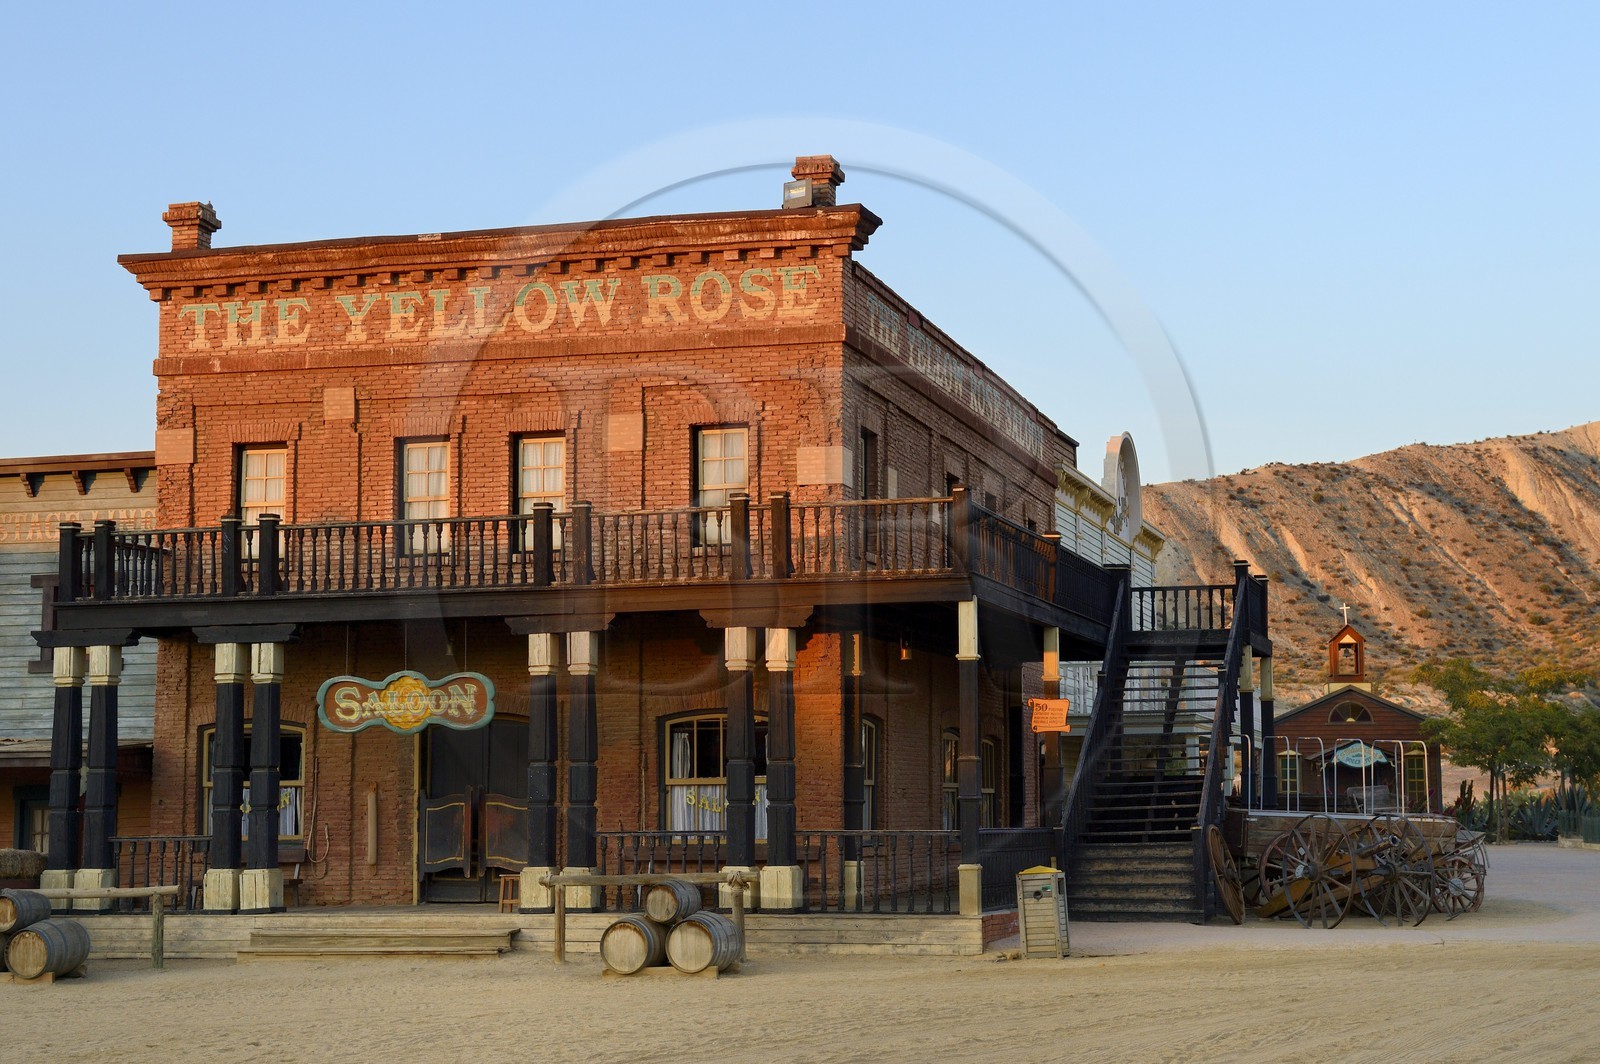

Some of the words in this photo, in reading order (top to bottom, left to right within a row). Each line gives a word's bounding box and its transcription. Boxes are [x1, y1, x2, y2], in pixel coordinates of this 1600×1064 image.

[179, 298, 311, 350] THE
[335, 278, 621, 345] YELLOW
[641, 265, 822, 325] ROSE
[867, 291, 900, 357] THE
[907, 322, 965, 400] YELLOW
[969, 368, 1001, 428] ROSE
[1005, 398, 1044, 461] SALOON
[335, 683, 478, 722] SALOON
[1035, 703, 1048, 712] 50
